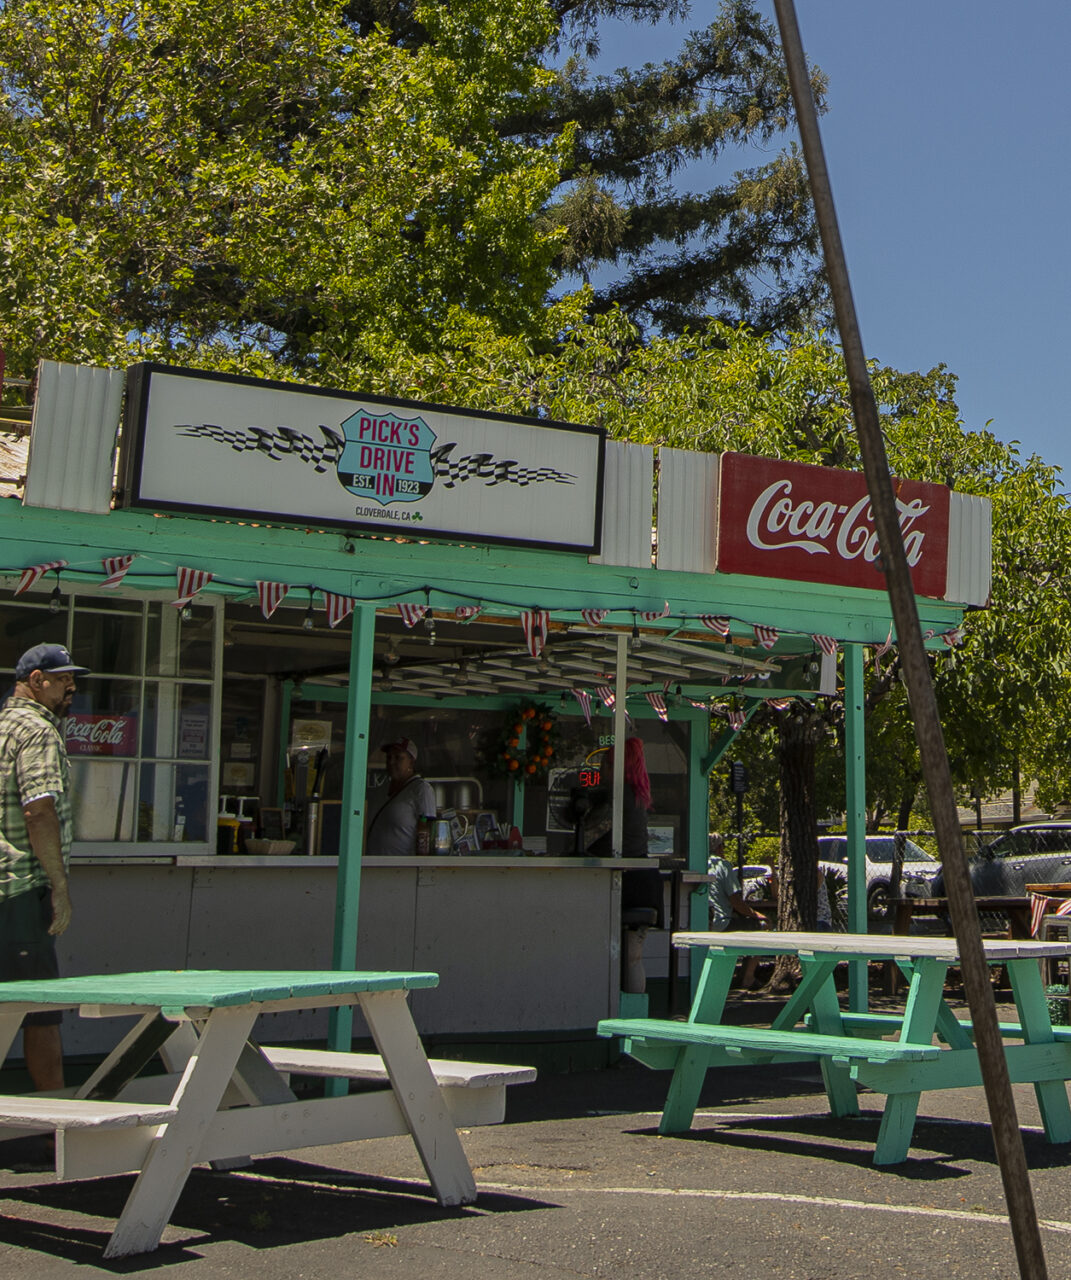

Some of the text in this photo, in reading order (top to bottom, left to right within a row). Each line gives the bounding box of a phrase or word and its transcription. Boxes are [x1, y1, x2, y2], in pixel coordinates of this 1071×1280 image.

[359, 417, 420, 447] PICK'S
[360, 445, 415, 475] DRIVE
[352, 474, 420, 493] EST. 1923
[376, 472, 395, 497] IN
[355, 506, 410, 521] CLOVERDALE, CA
[599, 735, 615, 746] BES
